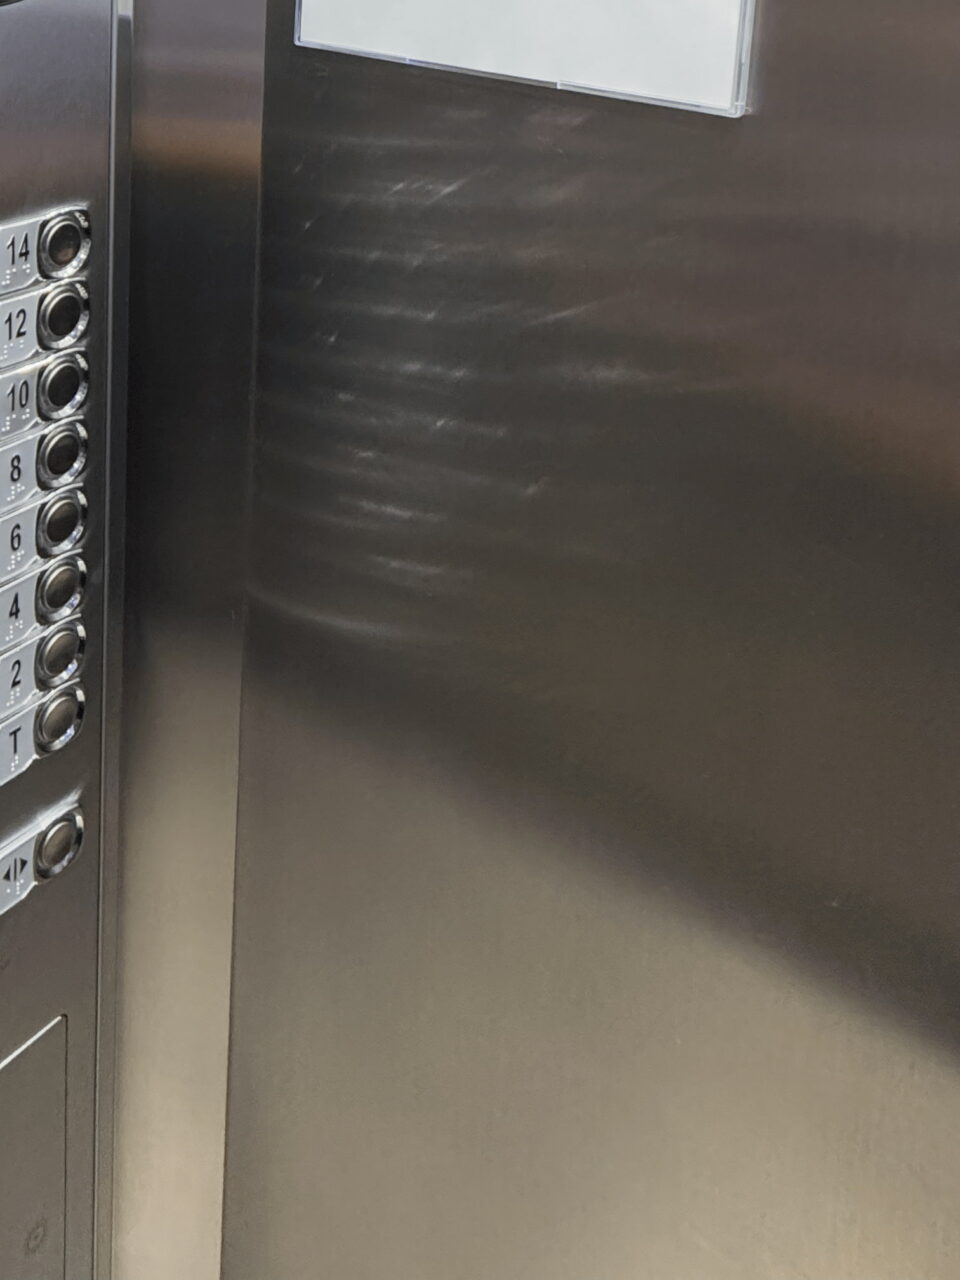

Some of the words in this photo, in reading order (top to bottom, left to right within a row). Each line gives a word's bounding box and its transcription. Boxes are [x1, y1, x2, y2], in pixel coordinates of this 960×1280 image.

[6, 232, 30, 266] 14
[4, 308, 27, 340] 12
[7, 380, 29, 412] 10
[10, 454, 22, 482] 8
[10, 523, 21, 551] 6
[8, 592, 20, 620] 4
[10, 659, 22, 689] 2
[8, 726, 22, 755] T
